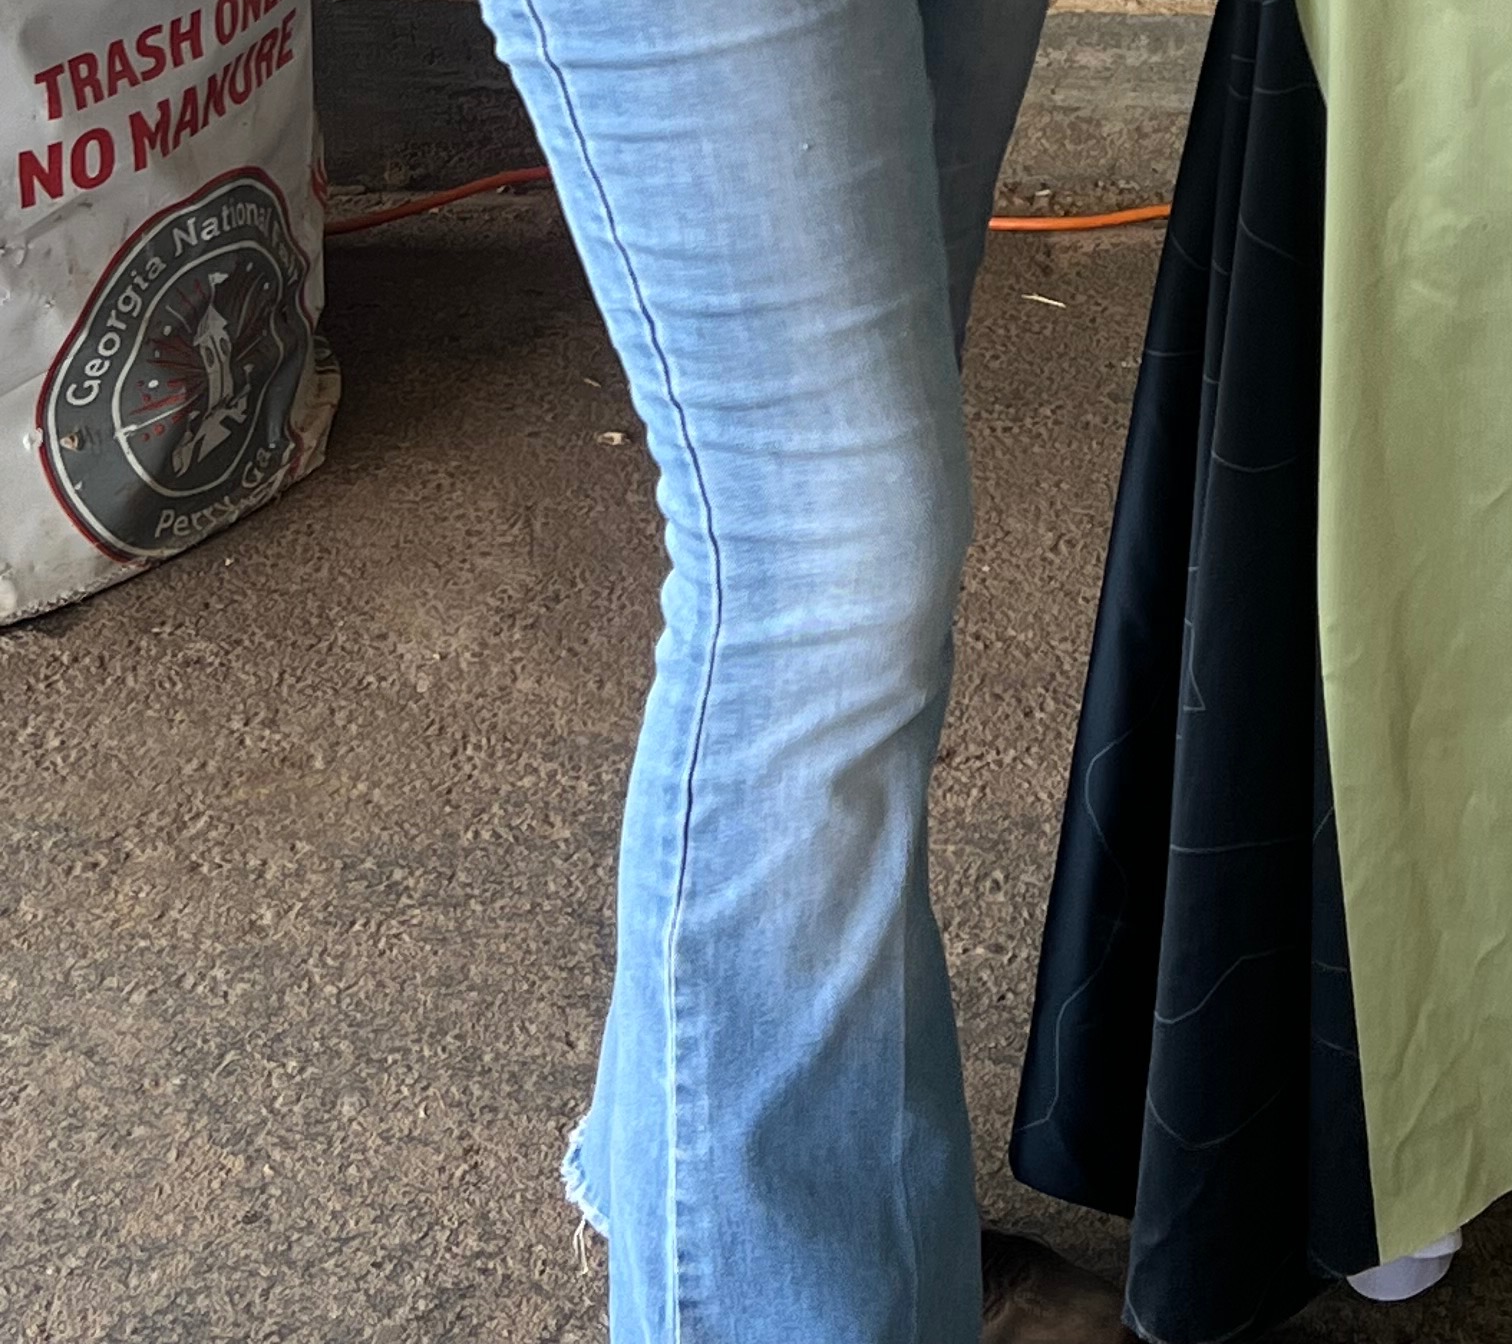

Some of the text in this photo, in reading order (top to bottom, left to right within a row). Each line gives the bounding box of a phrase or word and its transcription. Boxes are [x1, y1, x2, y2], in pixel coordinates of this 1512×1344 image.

[17, 6, 298, 210] NO MANURE
[34, 8, 204, 122] TRASH
[65, 254, 167, 408] Georgia
[172, 198, 271, 259] National
